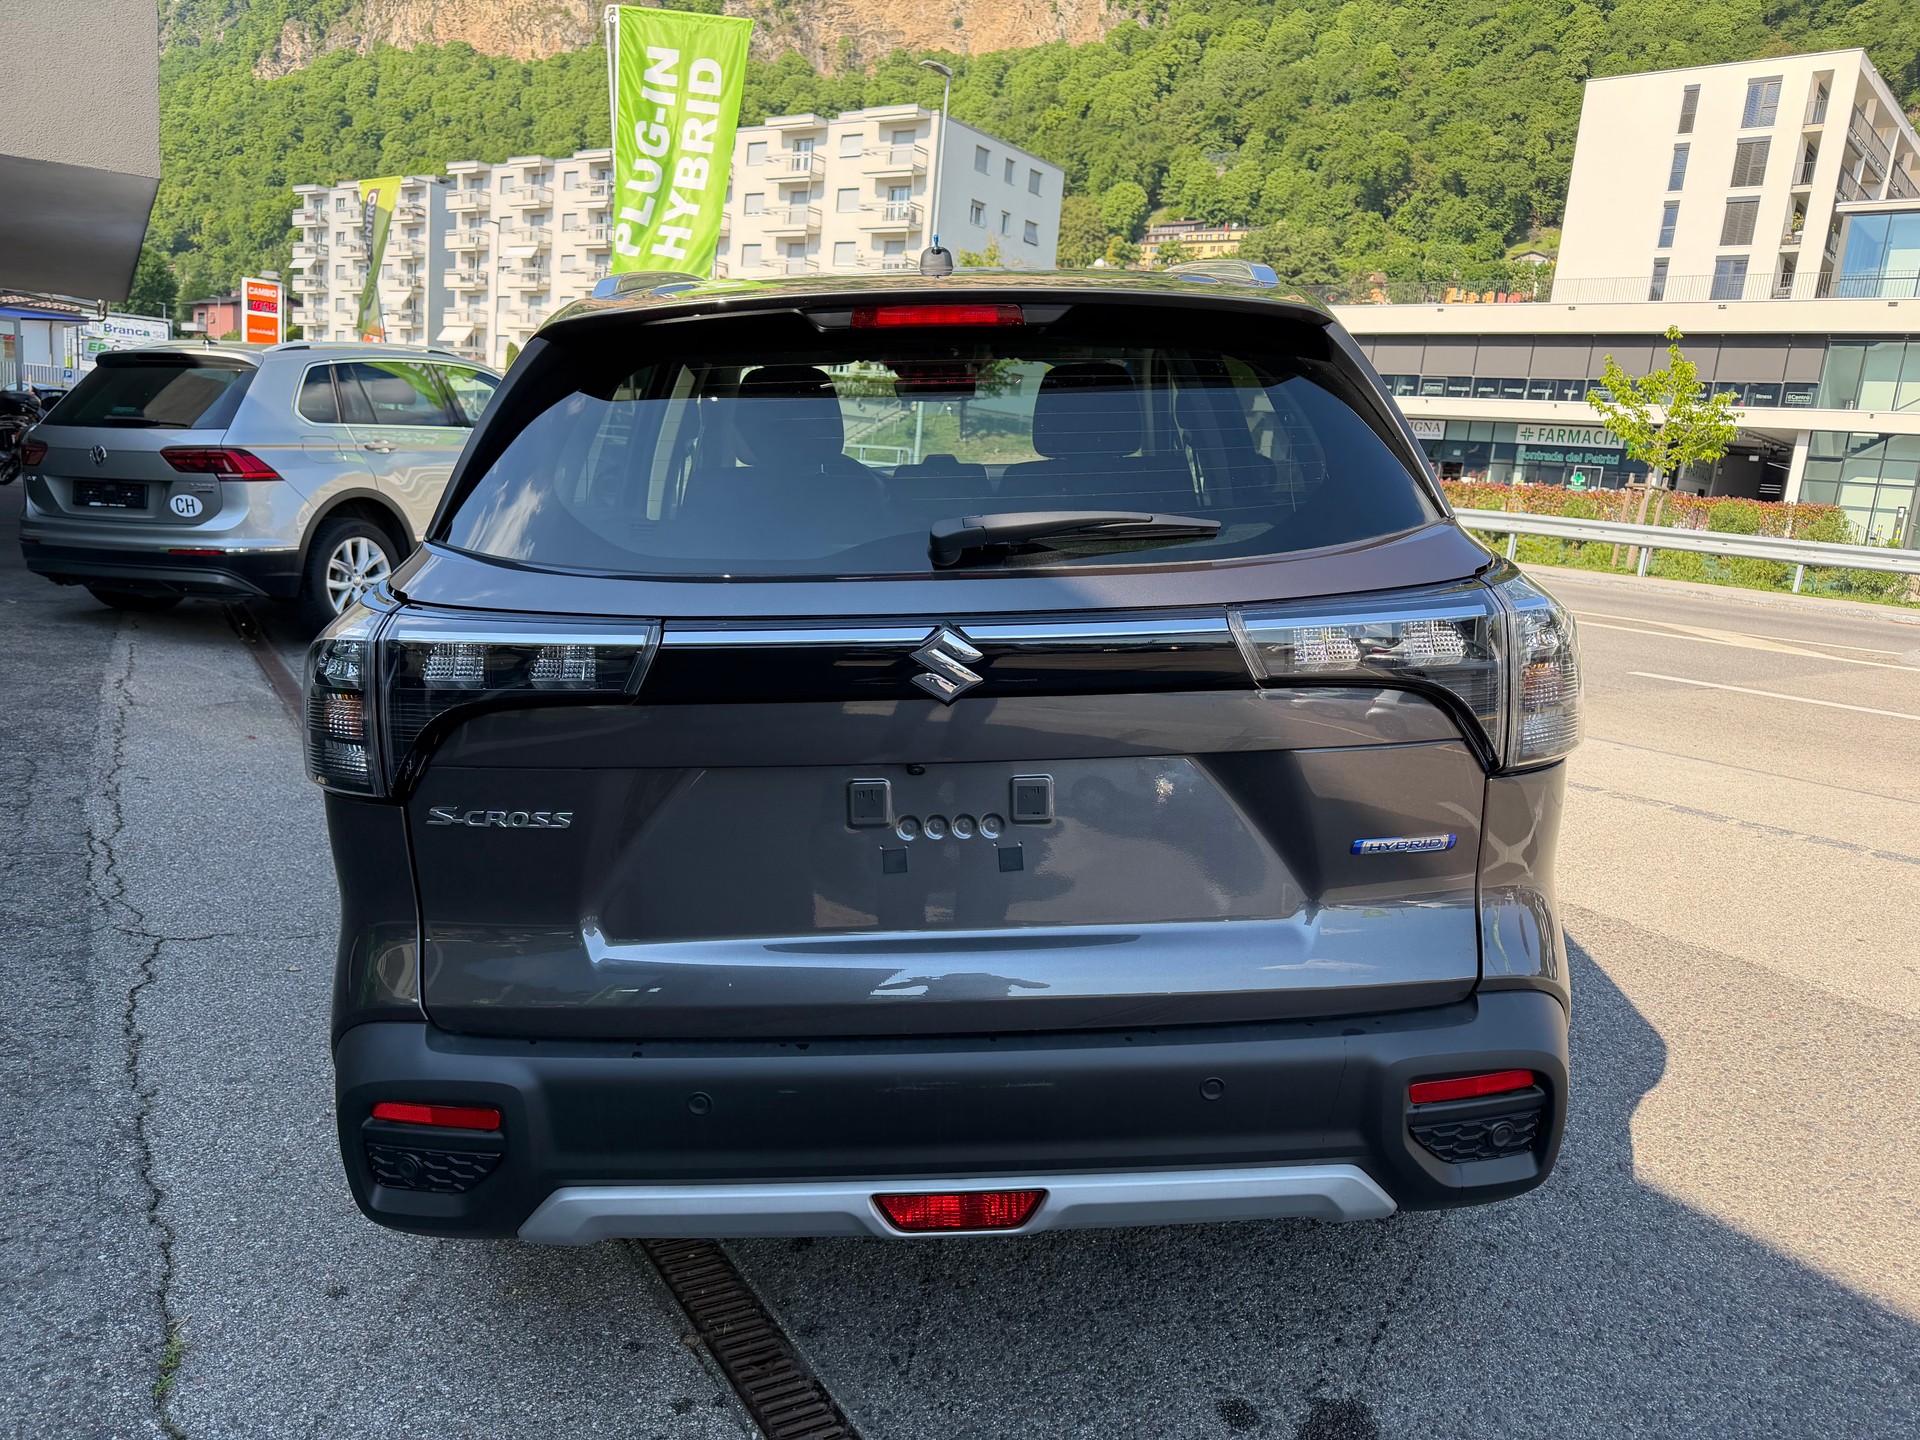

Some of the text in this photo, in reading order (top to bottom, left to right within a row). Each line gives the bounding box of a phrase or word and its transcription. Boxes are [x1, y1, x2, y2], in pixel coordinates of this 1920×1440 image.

[615, 46, 680, 257] PLUG-IN
[651, 58, 722, 260] HYBRID
[248, 286, 277, 298] CAMBIO
[103, 323, 150, 337] Branca
[1409, 421, 1441, 433] IGNA
[1537, 427, 1620, 446] FARMACIA
[1516, 449, 1564, 462] Contrada
[1584, 453, 1620, 465] Patrizi
[175, 497, 196, 514] CH
[425, 805, 575, 829] S-CROSS
[1368, 838, 1442, 852] HYBRID
